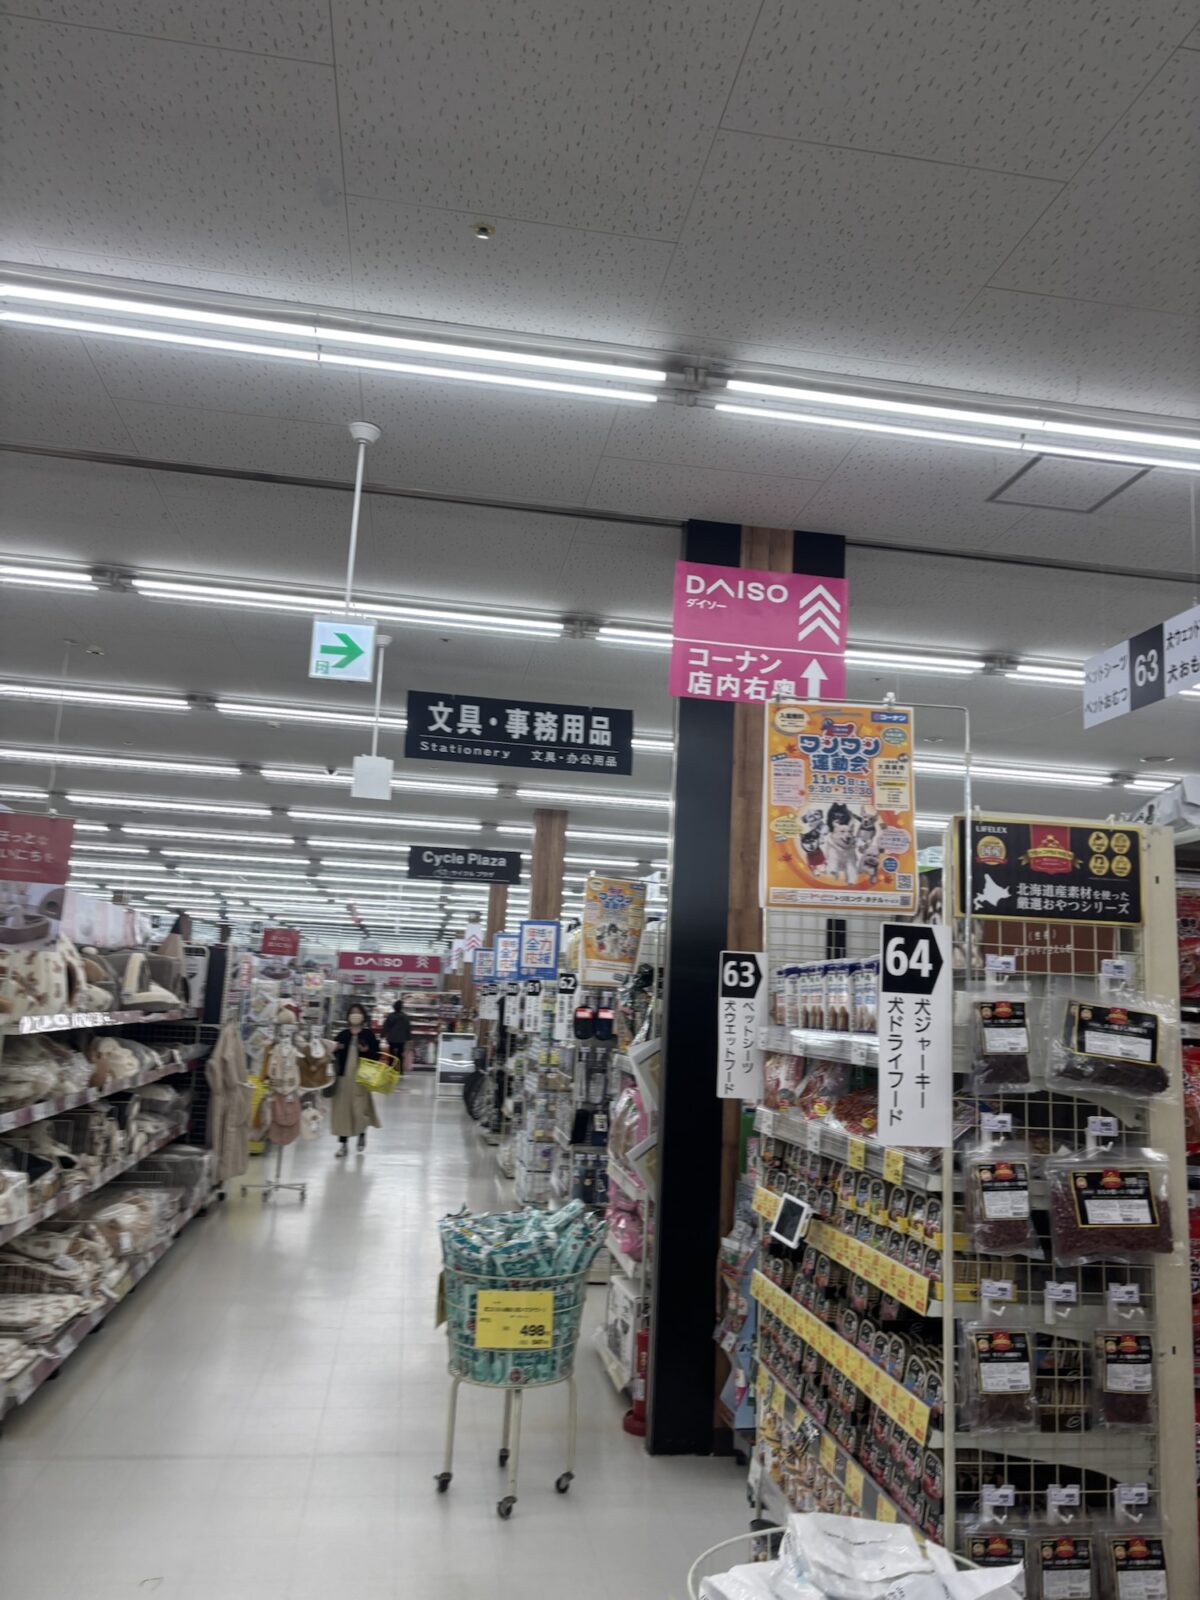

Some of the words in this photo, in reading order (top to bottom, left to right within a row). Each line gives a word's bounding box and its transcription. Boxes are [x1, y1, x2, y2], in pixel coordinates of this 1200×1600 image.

[685, 575, 788, 603] DAISO
[686, 599, 727, 609] ダイソー
[688, 648, 782, 674] コーナン
[1134, 649, 1159, 687] 63
[427, 701, 612, 746] 文具・事務用品
[420, 741, 511, 759] Stationery
[800, 736, 880, 756] ワンワン
[812, 753, 868, 772] 運動会
[422, 851, 465, 866] Cycle
[467, 853, 507, 867] Plaza
[1017, 883, 1130, 901] 北海道産素材を使った
[354, 956, 403, 968] DAISO
[885, 936, 933, 978] 64
[559, 976, 576, 990] 62
[723, 960, 755, 988] 63
[742, 1002, 754, 1074] ペットシーツ
[887, 997, 905, 1126] 犬ドライフード
[914, 998, 931, 1108] 犬ジャーキー
[520, 1325, 546, 1337] 498
